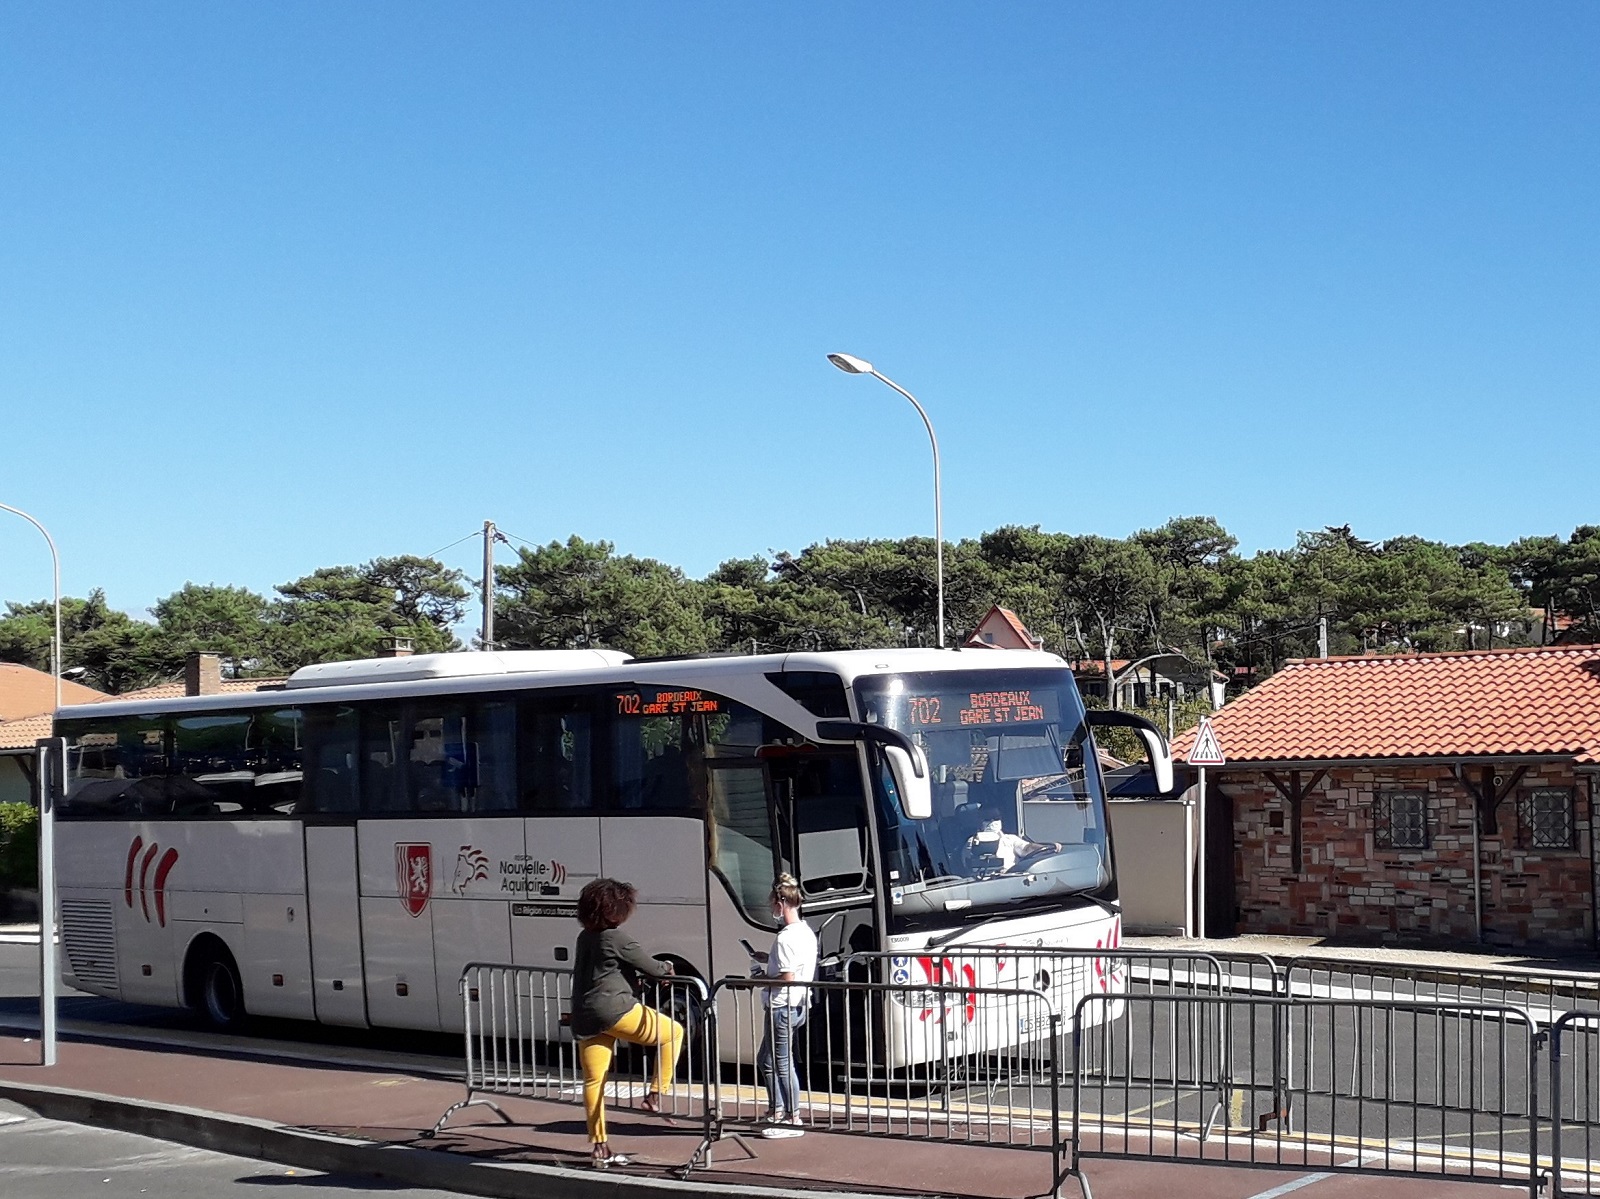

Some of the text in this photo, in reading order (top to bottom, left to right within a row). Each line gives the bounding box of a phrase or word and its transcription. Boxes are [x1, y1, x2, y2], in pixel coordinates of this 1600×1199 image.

[616, 693, 640, 715] 702
[656, 691, 702, 703] BORDEAUX
[969, 690, 1031, 709] BORDEAUX
[642, 700, 718, 714] GARE ST JEAN
[908, 697, 942, 725] 702
[960, 705, 1044, 725] GARE ST JEAN
